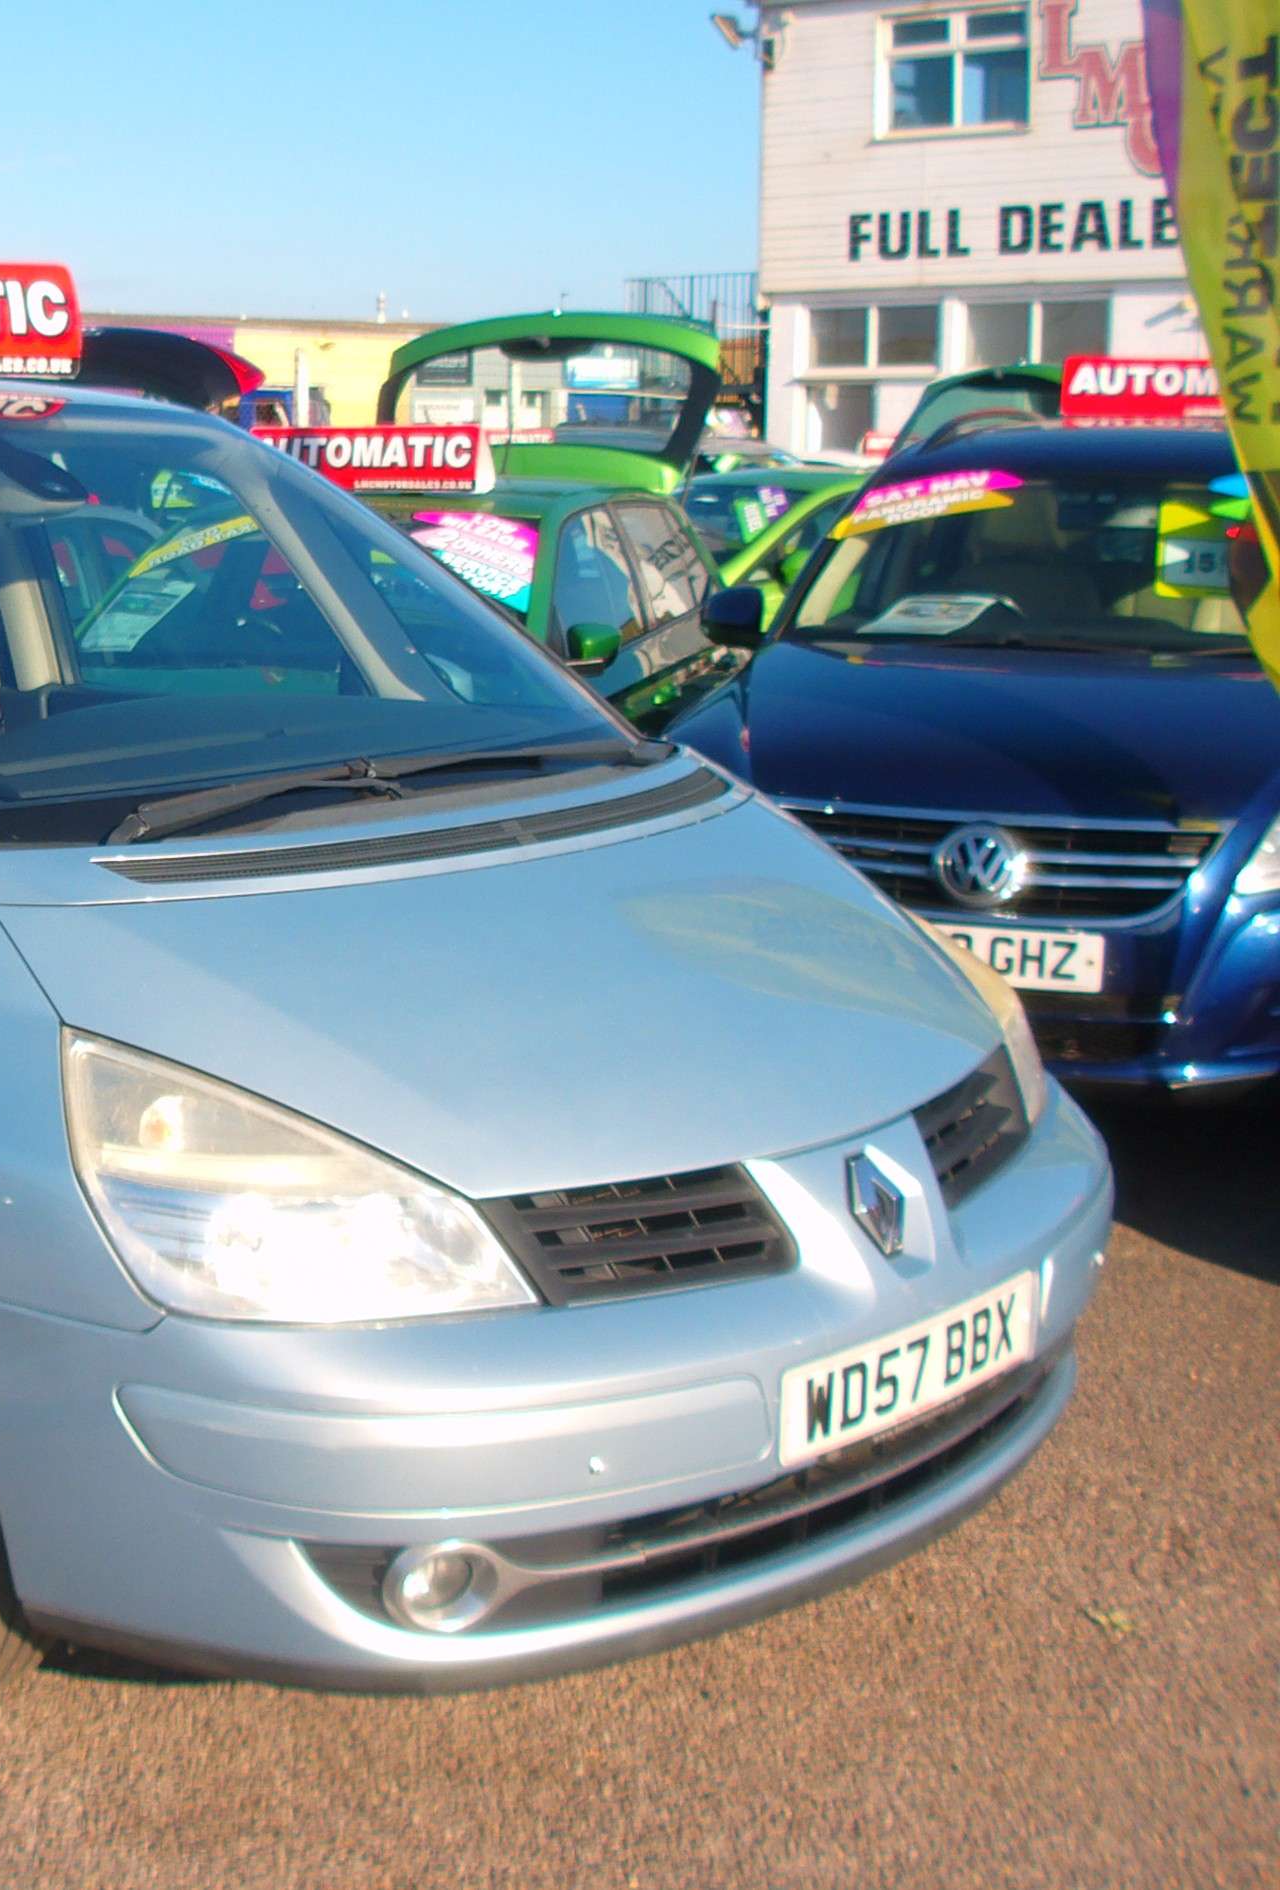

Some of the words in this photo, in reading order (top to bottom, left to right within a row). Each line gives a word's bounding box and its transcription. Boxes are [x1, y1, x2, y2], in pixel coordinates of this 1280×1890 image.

[847, 209, 971, 262] FULL
[999, 197, 1180, 255] DEALE
[1069, 363, 1219, 397] AUTOM
[262, 435, 472, 468] UTOMATIC
[990, 936, 1078, 980] GHZ
[807, 1335, 930, 1443] WD57
[944, 1293, 1015, 1387] BBX
